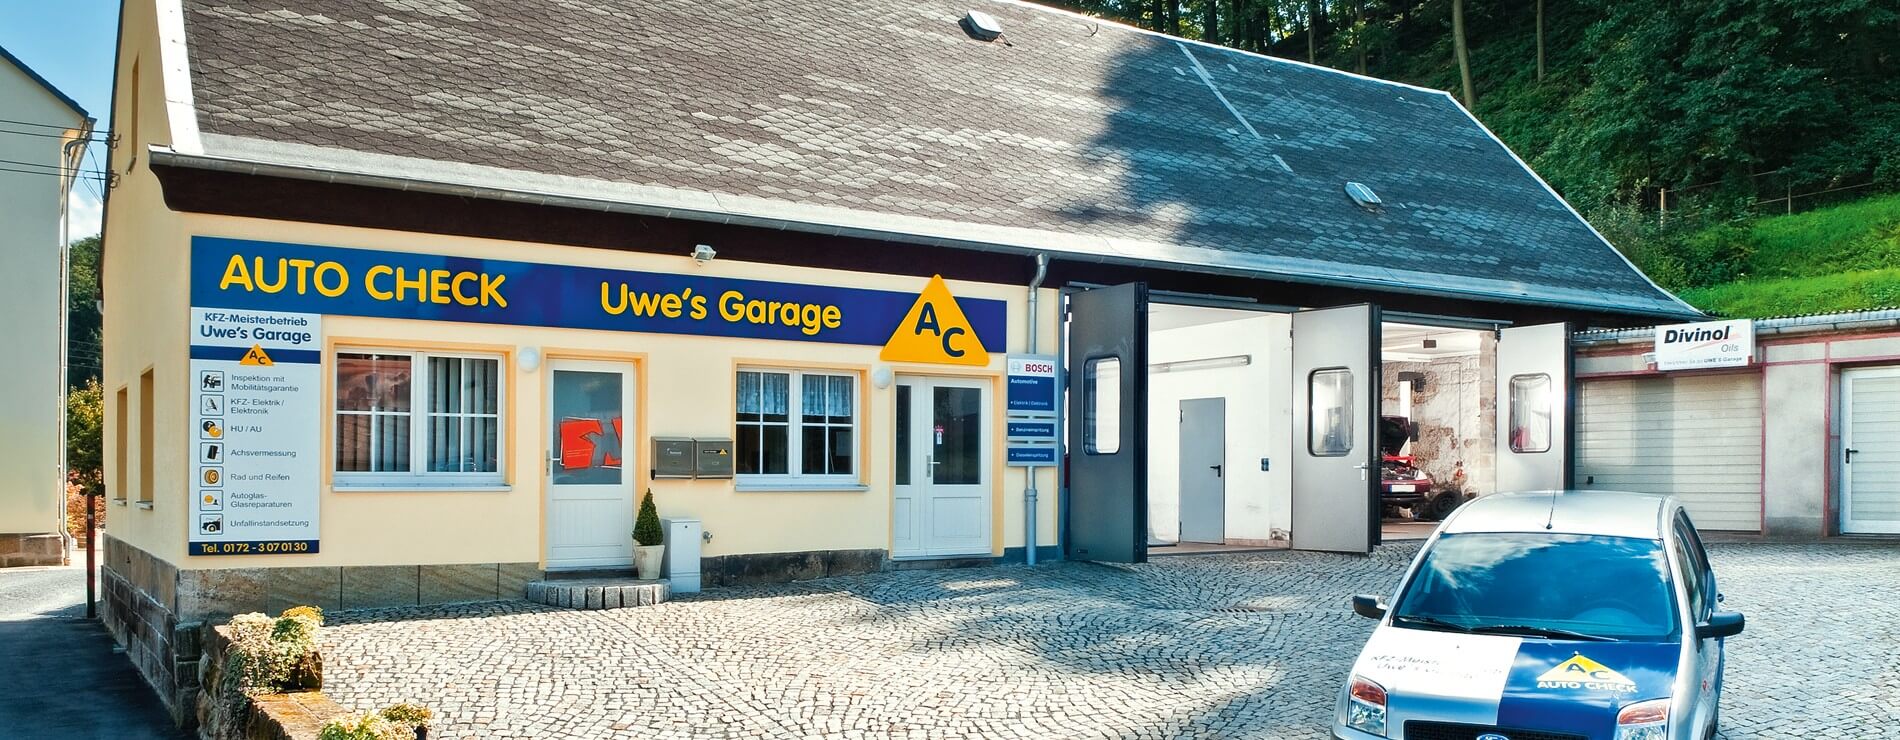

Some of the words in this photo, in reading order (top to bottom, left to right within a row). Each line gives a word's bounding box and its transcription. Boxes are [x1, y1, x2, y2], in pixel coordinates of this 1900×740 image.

[220, 254, 349, 297] AUTO
[365, 265, 508, 309] CHECK
[600, 281, 708, 320] Uwe's
[718, 290, 842, 335] Garage
[204, 312, 308, 327] KFZ-Meisterbetrieb
[200, 324, 248, 340] Uwe's
[252, 327, 312, 345] Garage
[1664, 325, 1730, 344] Divinol
[1721, 344, 1739, 352] Oils
[1025, 363, 1053, 373] BOSCH
[231, 374, 271, 383] Inspektion
[273, 375, 285, 383] mit
[231, 383, 299, 393] Mobilitätsgarantie
[230, 398, 250, 406] KFZ-
[252, 398, 281, 406] Elektrik
[230, 407, 269, 415] Elektronik
[230, 449, 297, 457] Achsvermessung
[230, 492, 268, 500] Autoglas-
[230, 500, 293, 509] Glasreparaturen
[230, 519, 310, 528] Unfallinstandsetzung
[202, 543, 220, 553] Tel.
[223, 543, 250, 553] 0172
[1537, 681, 1582, 689] AUTO
[1584, 682, 1639, 693] CHECK
